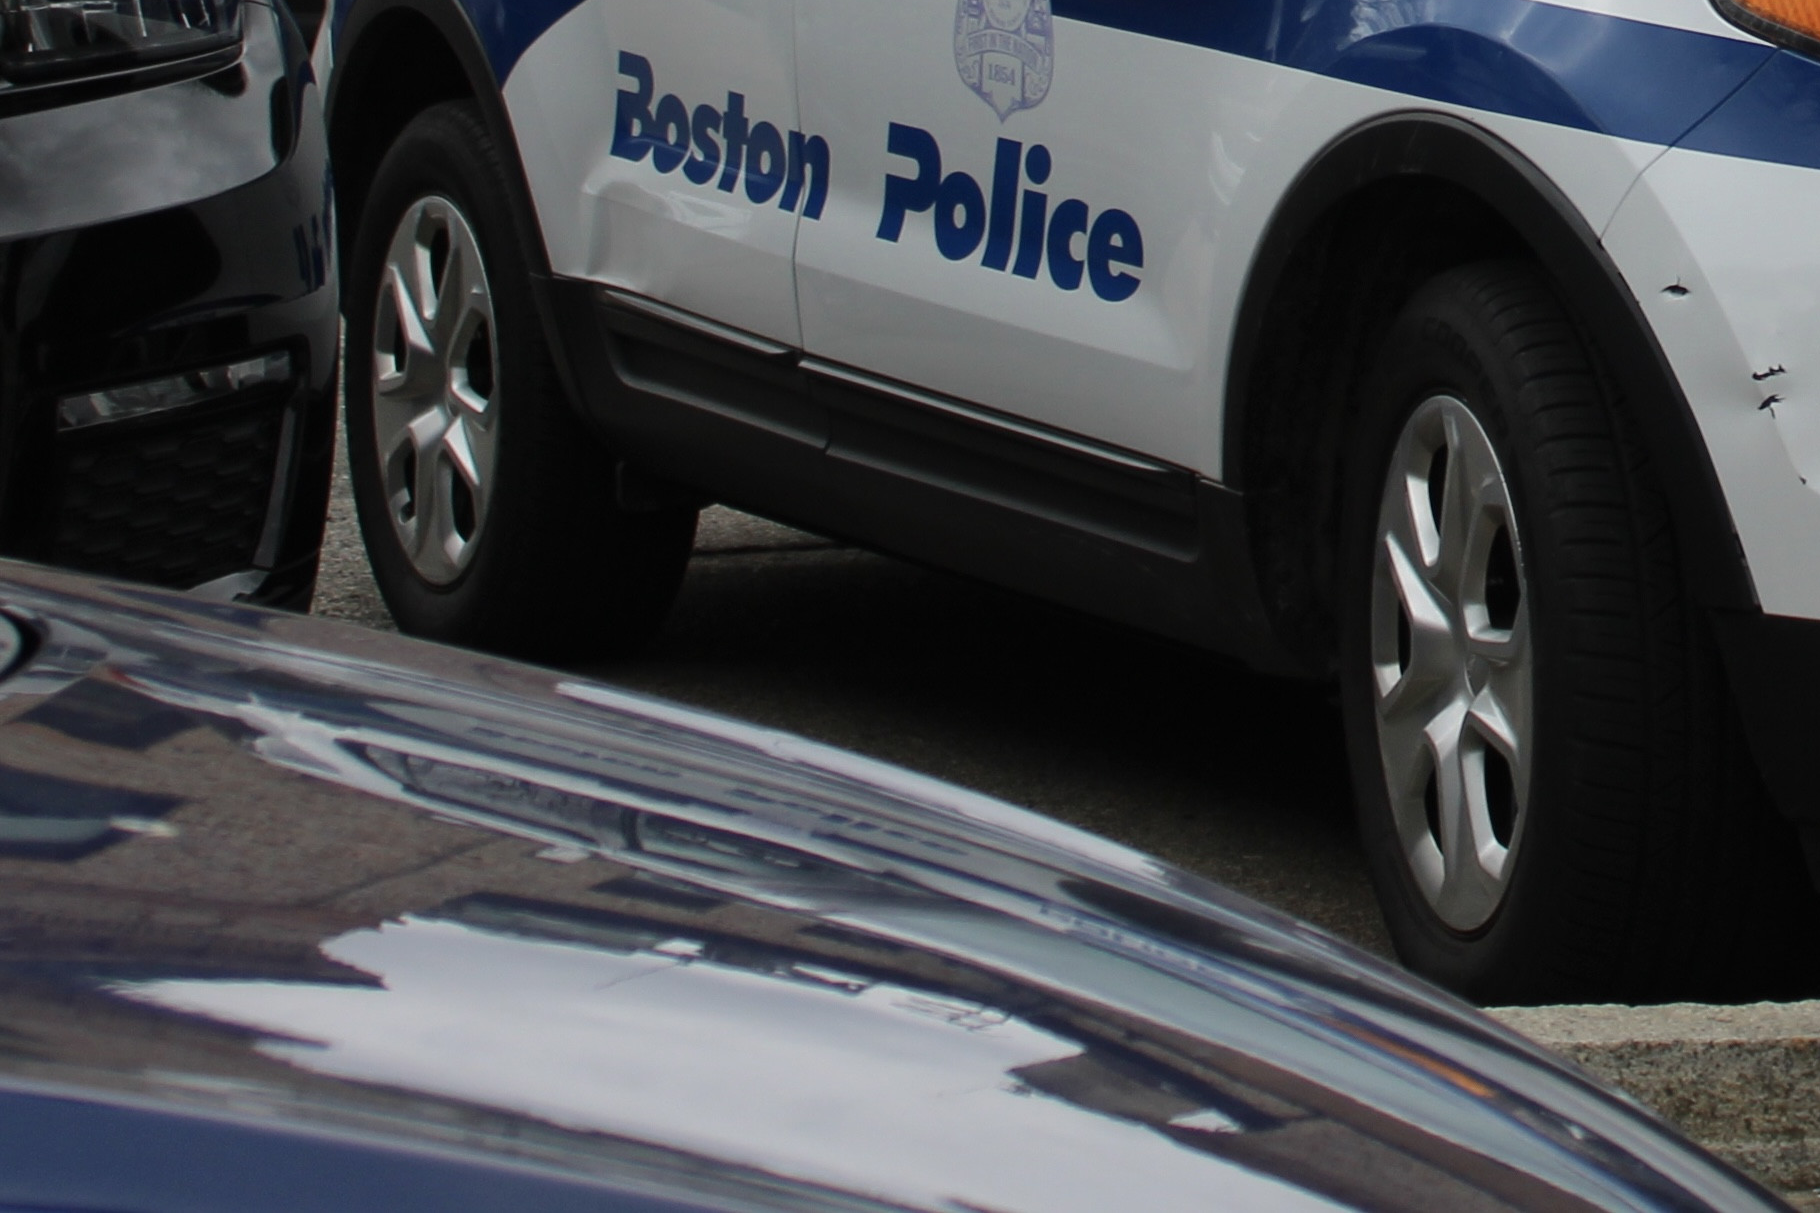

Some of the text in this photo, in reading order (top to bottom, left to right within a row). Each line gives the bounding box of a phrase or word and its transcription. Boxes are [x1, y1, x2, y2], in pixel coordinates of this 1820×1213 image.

[987, 63, 1016, 86] 1854
[610, 50, 1144, 303] Boston Police
